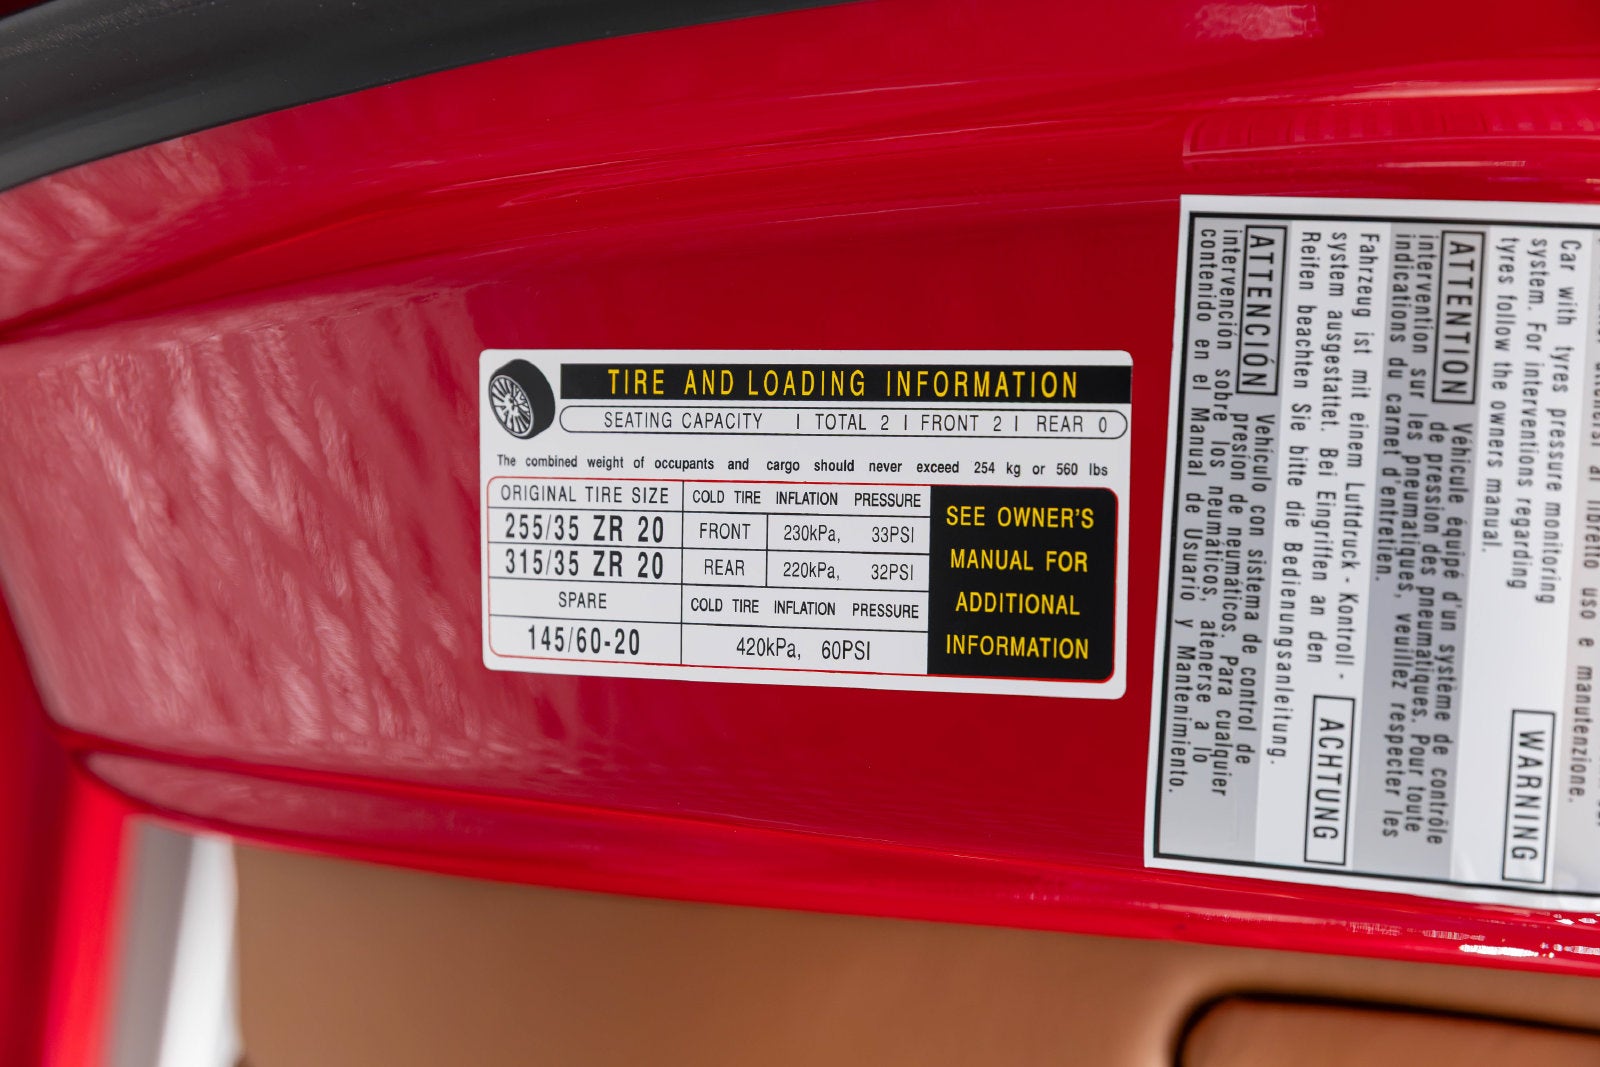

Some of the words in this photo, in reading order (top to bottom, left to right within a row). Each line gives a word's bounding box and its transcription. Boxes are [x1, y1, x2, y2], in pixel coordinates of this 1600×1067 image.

[1196, 229, 1218, 322] contenido
[1299, 232, 1322, 290] Reifen
[1326, 232, 1350, 296] system
[1351, 233, 1380, 317] Fahrzeug
[1496, 238, 1520, 284] tyres
[1526, 238, 1550, 310] system.
[1560, 240, 1582, 271] Car
[1216, 230, 1243, 350] intervención
[1390, 234, 1416, 342] indications
[1413, 235, 1438, 353] intervention
[1557, 287, 1578, 325] with
[1242, 234, 1275, 386] ATTENCIÓN
[1441, 241, 1476, 394] ATTENTION
[1494, 295, 1518, 351] follow
[1194, 339, 1210, 360] en
[1293, 305, 1318, 388] beachten
[1353, 332, 1375, 354] ist
[1526, 322, 1547, 352] For
[608, 369, 664, 394] TIRE
[684, 370, 733, 395] AND
[749, 370, 864, 396] LOADING
[888, 371, 1076, 398] INFORMATION
[1192, 374, 1212, 390] el
[1320, 310, 1343, 431] ausgestattet.
[1351, 369, 1371, 398] mit
[1388, 358, 1408, 378] du
[1410, 369, 1426, 398] sur
[1491, 362, 1513, 390] the
[1550, 346, 1574, 392] tyres
[1212, 369, 1234, 422] sobre
[604, 412, 672, 428] SEATING
[682, 412, 762, 430] CAPACITY
[815, 413, 866, 430] TOTAL
[881, 415, 889, 430] 2
[922, 414, 979, 431] FRONT
[994, 416, 1002, 432] 2
[1037, 415, 1083, 432] REAR
[1098, 416, 1107, 433] 0
[1290, 403, 1312, 431] Sie
[1384, 394, 1402, 454] carnet
[1407, 414, 1427, 440] les
[1429, 422, 1448, 442] de
[1486, 400, 1506, 468] owners
[1516, 362, 1545, 487] interventions
[1187, 408, 1210, 476] Manual
[1209, 441, 1231, 468] los
[1251, 414, 1276, 492] Vehículo
[1347, 412, 1369, 468] einem
[1546, 408, 1566, 492] pressure
[497, 454, 516, 466] The
[526, 455, 577, 468] combined
[587, 456, 624, 471] weight
[634, 456, 644, 468] of
[654, 458, 714, 472] occupants
[728, 458, 749, 470] and
[767, 461, 800, 474] cargo
[814, 459, 854, 472] should
[869, 462, 902, 472] never
[916, 461, 959, 473] exceed
[974, 461, 995, 474] 254
[1006, 462, 1021, 478] kg
[1032, 465, 1046, 475] or
[1056, 462, 1078, 476] 560
[1089, 463, 1108, 476] lbs
[1287, 446, 1310, 486] bitte
[1318, 448, 1339, 476] Bei
[1448, 423, 1473, 504] Véhicule
[501, 484, 576, 502] ORIGINAL
[585, 486, 622, 503] TIRE
[632, 487, 668, 504] SIZE
[692, 490, 724, 503] COLD
[734, 490, 761, 504] TIRE
[776, 491, 838, 506] INFLATION
[855, 492, 921, 508] PRESSURE
[1185, 493, 1206, 514] de
[1228, 494, 1248, 514] de
[1424, 454, 1444, 532] pression
[506, 512, 578, 541] 255/35
[593, 514, 622, 542] ZR
[638, 516, 663, 543] 20
[700, 522, 751, 540] FRONT
[784, 524, 840, 544] 230kPa,
[872, 526, 914, 543] 33PSI
[946, 506, 984, 526] SEE
[1249, 505, 1266, 536] con
[1284, 501, 1306, 528] die
[1310, 490, 1337, 580] Eingriffen
[1341, 482, 1366, 569] Luftdruck
[1396, 456, 1420, 597] pneumatiques,
[1482, 478, 1502, 552] manual.
[506, 548, 578, 576] 315/35
[593, 550, 622, 577] ZR
[638, 552, 663, 580] 20
[951, 549, 1034, 570] MANUAL
[1046, 551, 1087, 572] FOR
[1180, 528, 1204, 600] Usuario
[1199, 486, 1225, 601] neumáticos,
[1421, 544, 1440, 574] des
[1440, 517, 1467, 579] équipé
[1506, 498, 1533, 589] regarding
[1534, 502, 1563, 604] monitoring
[704, 559, 744, 576] REAR
[783, 562, 839, 581] 220kPa,
[871, 564, 913, 580] 32PSI
[1221, 527, 1244, 638] neumáticos.
[1244, 549, 1267, 620] sistema
[559, 591, 606, 609] SPARE
[691, 598, 723, 612] COLD
[732, 599, 759, 613] TIRE
[774, 600, 835, 616] INFLATION
[853, 603, 919, 619] PRESSURE
[956, 592, 1080, 615] ADDITIONAL
[1310, 595, 1326, 616] an
[1580, 588, 1597, 619] uso
[528, 625, 639, 656] 145/60-20
[1174, 619, 1194, 628] y
[1242, 634, 1262, 654] de
[1335, 592, 1359, 666] Kontroll
[1578, 638, 1594, 647] e
[736, 637, 800, 660] 420kPa,
[822, 640, 870, 660] 60PSI
[947, 634, 1088, 659] INFORMATION
[1196, 620, 1218, 702] atenerse
[1266, 542, 1304, 764] Bedienungsanleitung.
[1307, 631, 1328, 663] den
[1392, 614, 1412, 688] veuillez
[1410, 586, 1434, 722] pneumatiques.
[1217, 655, 1239, 696] Para
[1434, 644, 1457, 721] système
[1168, 646, 1197, 792] Mantenimiento.
[1238, 667, 1258, 731] control
[1194, 721, 1210, 730] a
[1432, 734, 1454, 755] de
[1568, 666, 1593, 802] manutenzione.
[1192, 747, 1212, 763] lo
[1208, 710, 1234, 796] cualquier
[1235, 744, 1256, 764] de
[1384, 704, 1405, 796] respecter
[1409, 734, 1430, 775] Pour
[1313, 718, 1345, 839] ACHTUNG
[1512, 731, 1545, 860] WARNING
[1383, 811, 1402, 836] les
[1405, 787, 1425, 831] toute
[1426, 768, 1448, 844] contrôle
